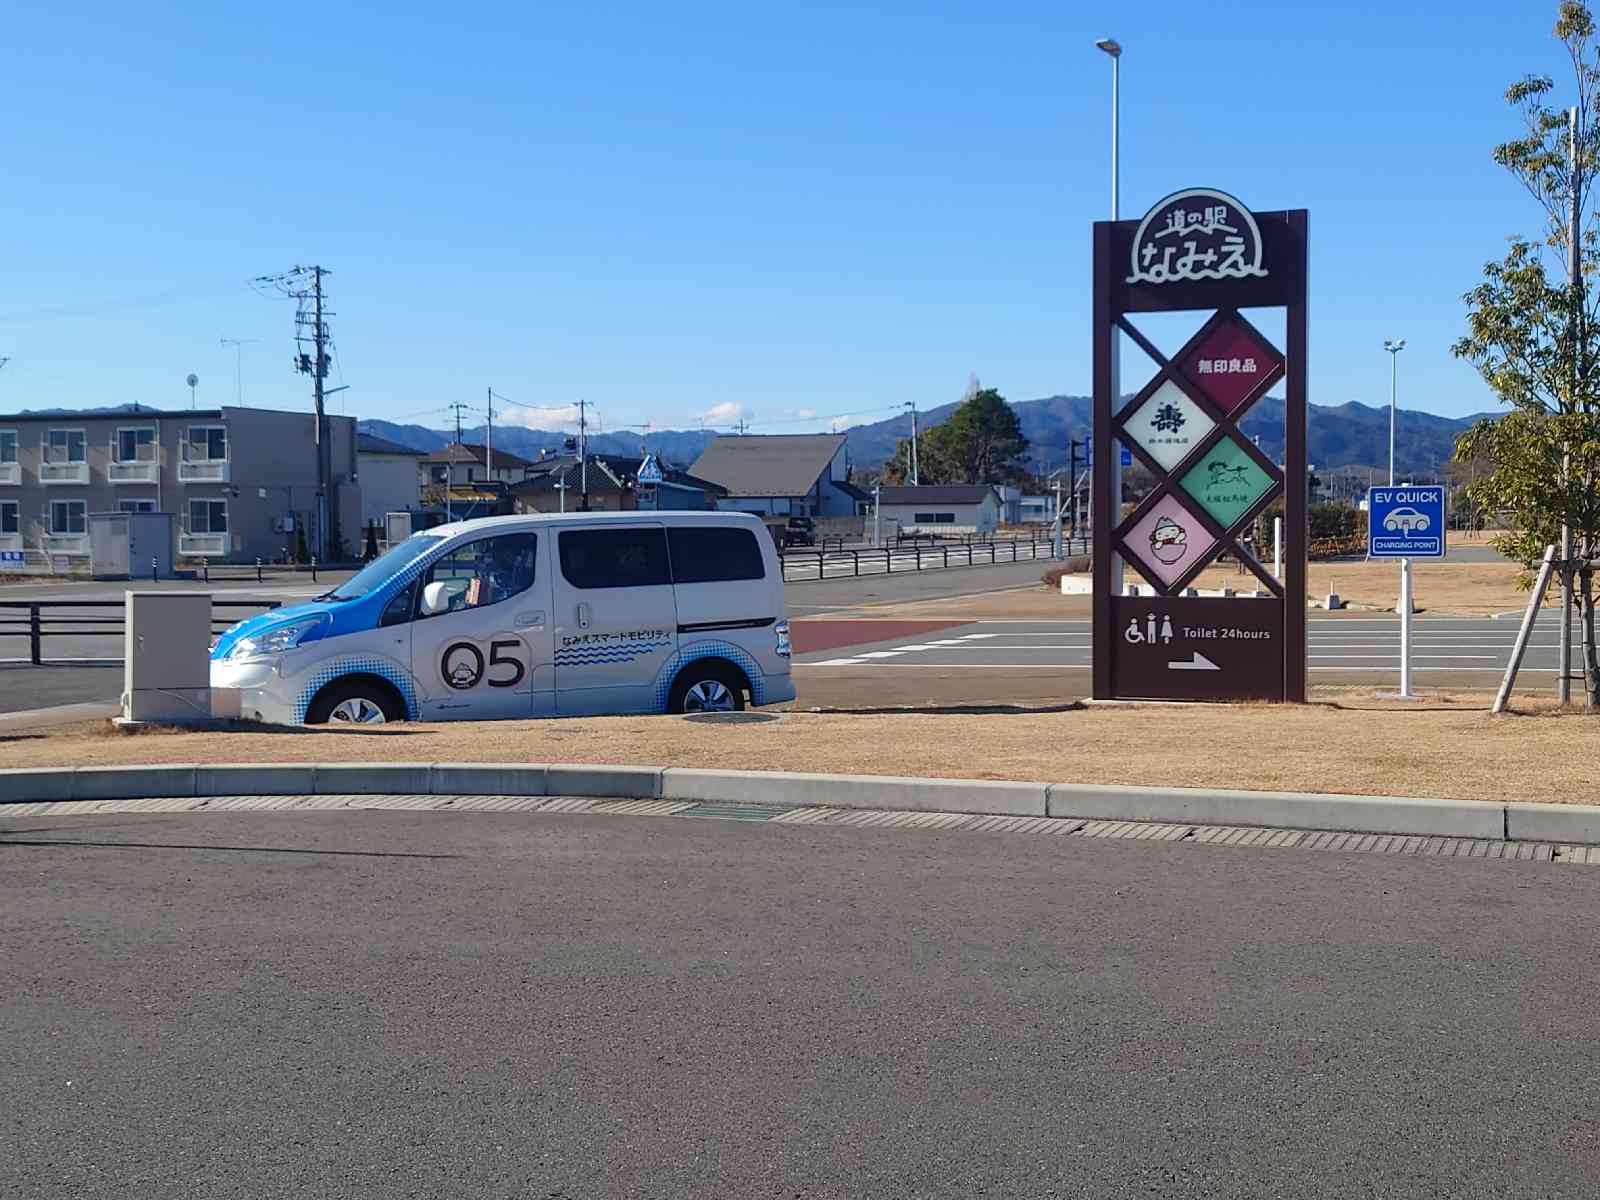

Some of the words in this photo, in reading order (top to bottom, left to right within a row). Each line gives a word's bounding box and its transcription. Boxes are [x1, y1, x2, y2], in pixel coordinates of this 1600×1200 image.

[1159, 205, 1233, 234] 道の駅
[1130, 236, 1260, 283] なみえ
[1198, 358, 1257, 374] 無印良品
[1375, 492, 1392, 503] EV
[1396, 492, 1438, 503] QUICK
[1375, 541, 1413, 549] CHARGING
[1413, 541, 1437, 549] POINT
[562, 629, 672, 646] なみえスマートモビリティ
[1183, 627, 1217, 639] Toilet
[1220, 628, 1271, 639] 24hours
[441, 640, 525, 690] 05
